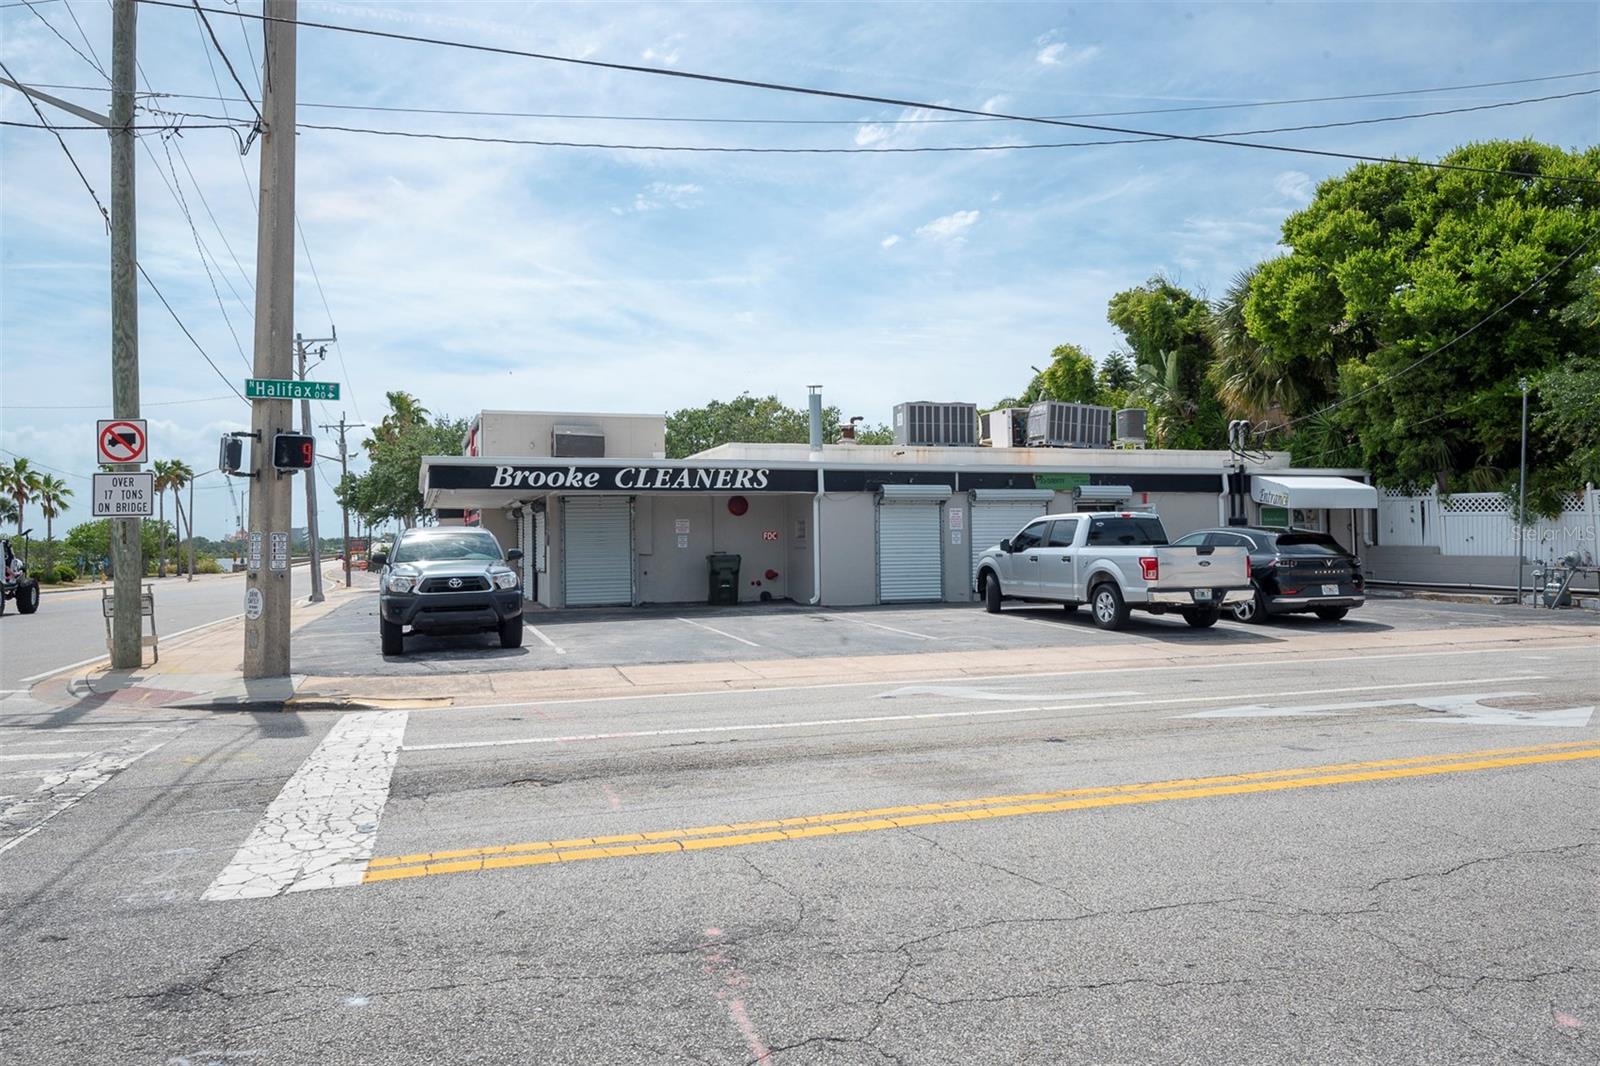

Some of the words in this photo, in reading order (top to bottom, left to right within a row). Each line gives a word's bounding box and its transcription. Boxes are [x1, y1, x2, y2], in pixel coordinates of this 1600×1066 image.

[256, 381, 312, 397] Halifax
[315, 383, 326, 391] Av
[302, 441, 312, 465] 9
[112, 477, 135, 488] OVER
[490, 466, 600, 489] Brooke
[615, 467, 770, 490] CLEANERS
[104, 489, 113, 500] 17
[121, 489, 144, 501] TONS
[98, 502, 110, 513] ON
[116, 502, 148, 513] BRIDGE
[763, 531, 777, 540] FDC
